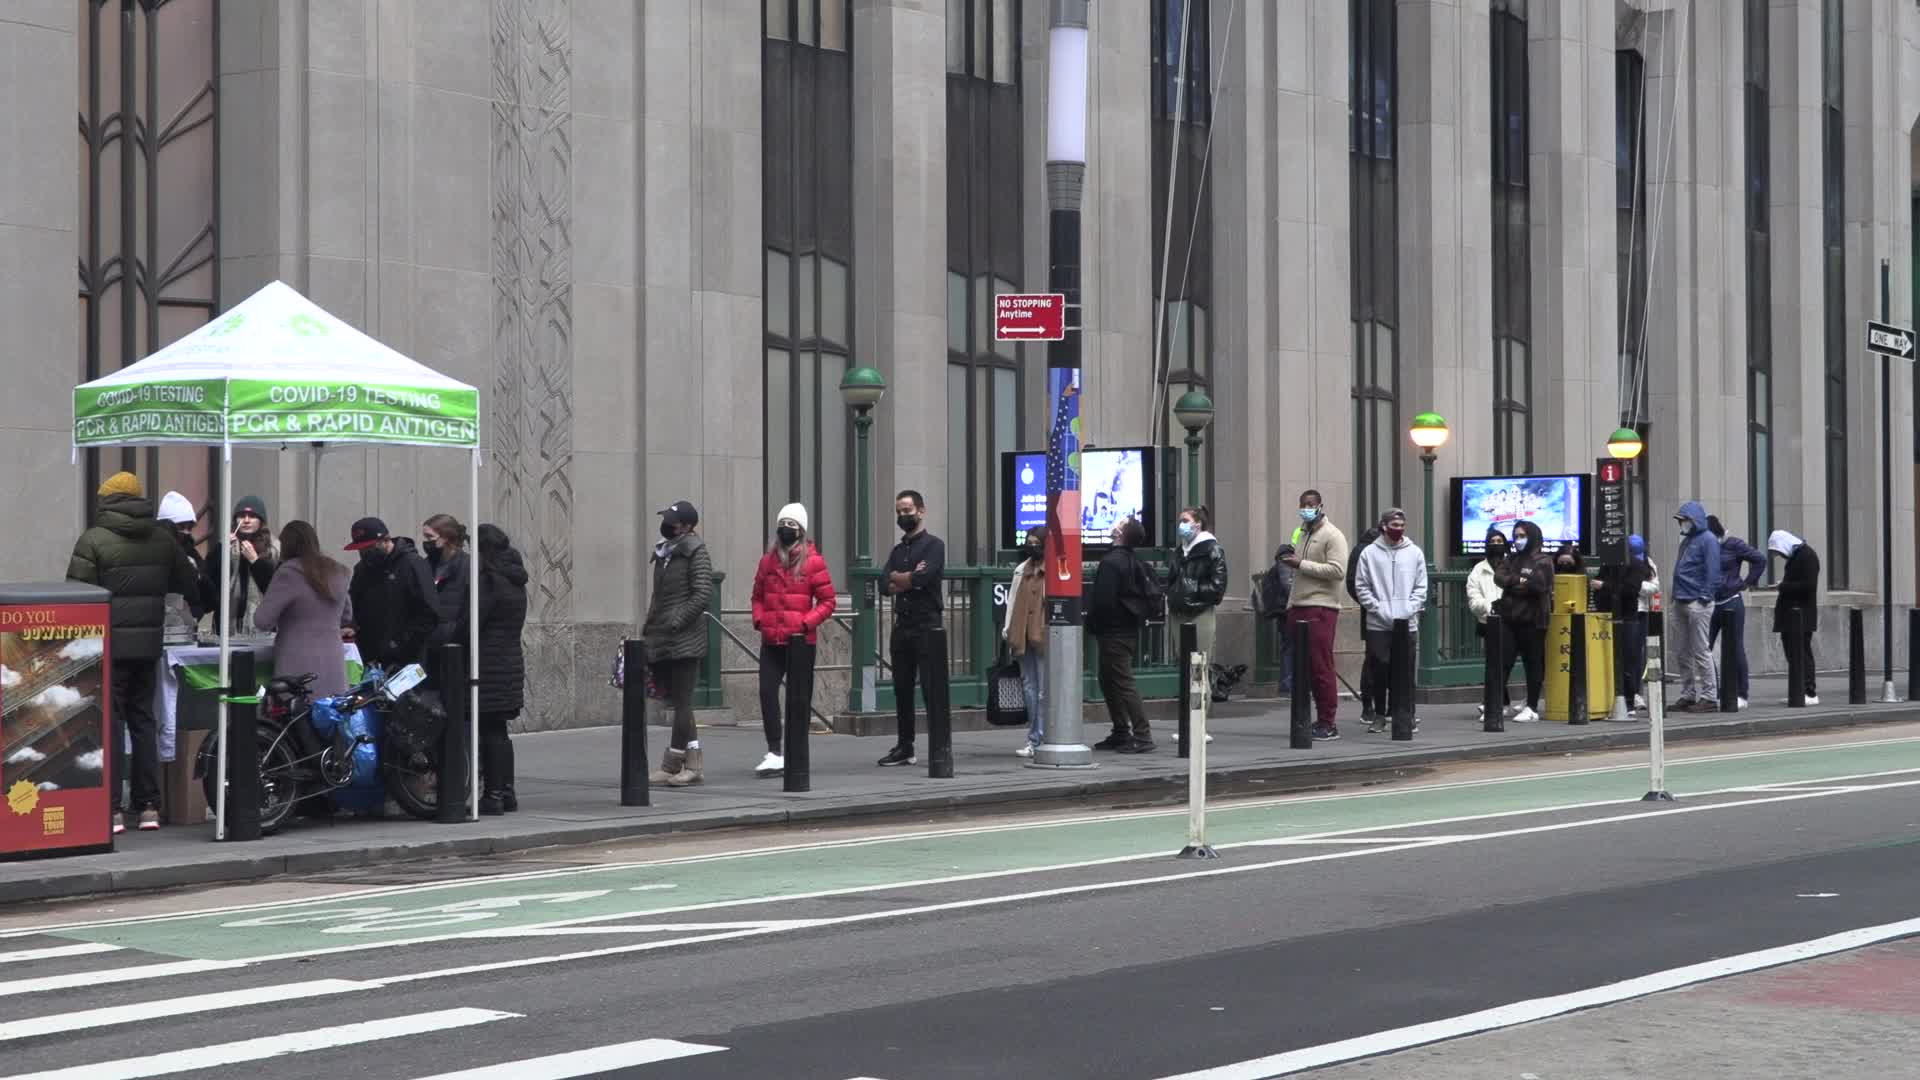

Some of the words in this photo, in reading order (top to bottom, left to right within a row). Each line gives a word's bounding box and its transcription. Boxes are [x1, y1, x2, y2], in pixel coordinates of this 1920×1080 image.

[999, 299, 1011, 309] NO
[1013, 299, 1052, 309] STOPPING
[1000, 310, 1033, 320] Anytime
[1874, 331, 1889, 346] ONE
[97, 384, 151, 407] COVID-19
[154, 385, 204, 403] TESTING
[270, 385, 357, 403] COVID-19
[363, 387, 441, 409] TESTING
[76, 418, 106, 438] PCR
[108, 417, 119, 434] &
[122, 413, 161, 432] RAPID
[164, 413, 224, 433] ANTIGEN
[232, 413, 279, 433] PCR
[286, 414, 302, 433] &
[308, 413, 374, 432] RAPID
[379, 414, 475, 440] ANTIGEN
[2, 611, 23, 625] DO
[23, 624, 105, 640] DOWNTOWN
